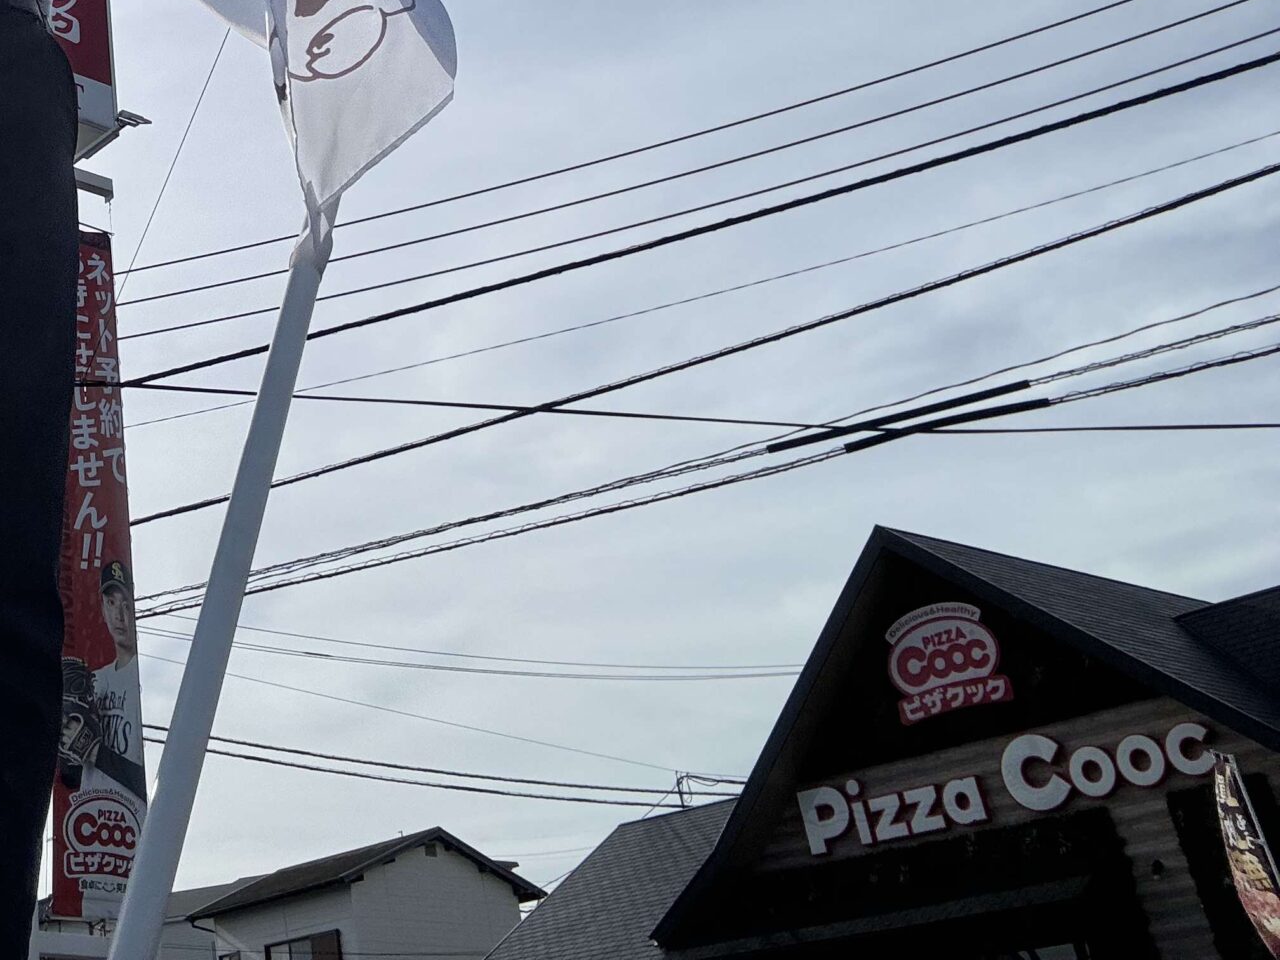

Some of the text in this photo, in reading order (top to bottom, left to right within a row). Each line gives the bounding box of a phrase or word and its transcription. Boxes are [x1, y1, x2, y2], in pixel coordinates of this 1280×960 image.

[922, 626, 967, 650] PIZZA
[903, 679, 1006, 721] ピザクック
[98, 809, 127, 824] PIZZA
[797, 778, 987, 856] Pizza
